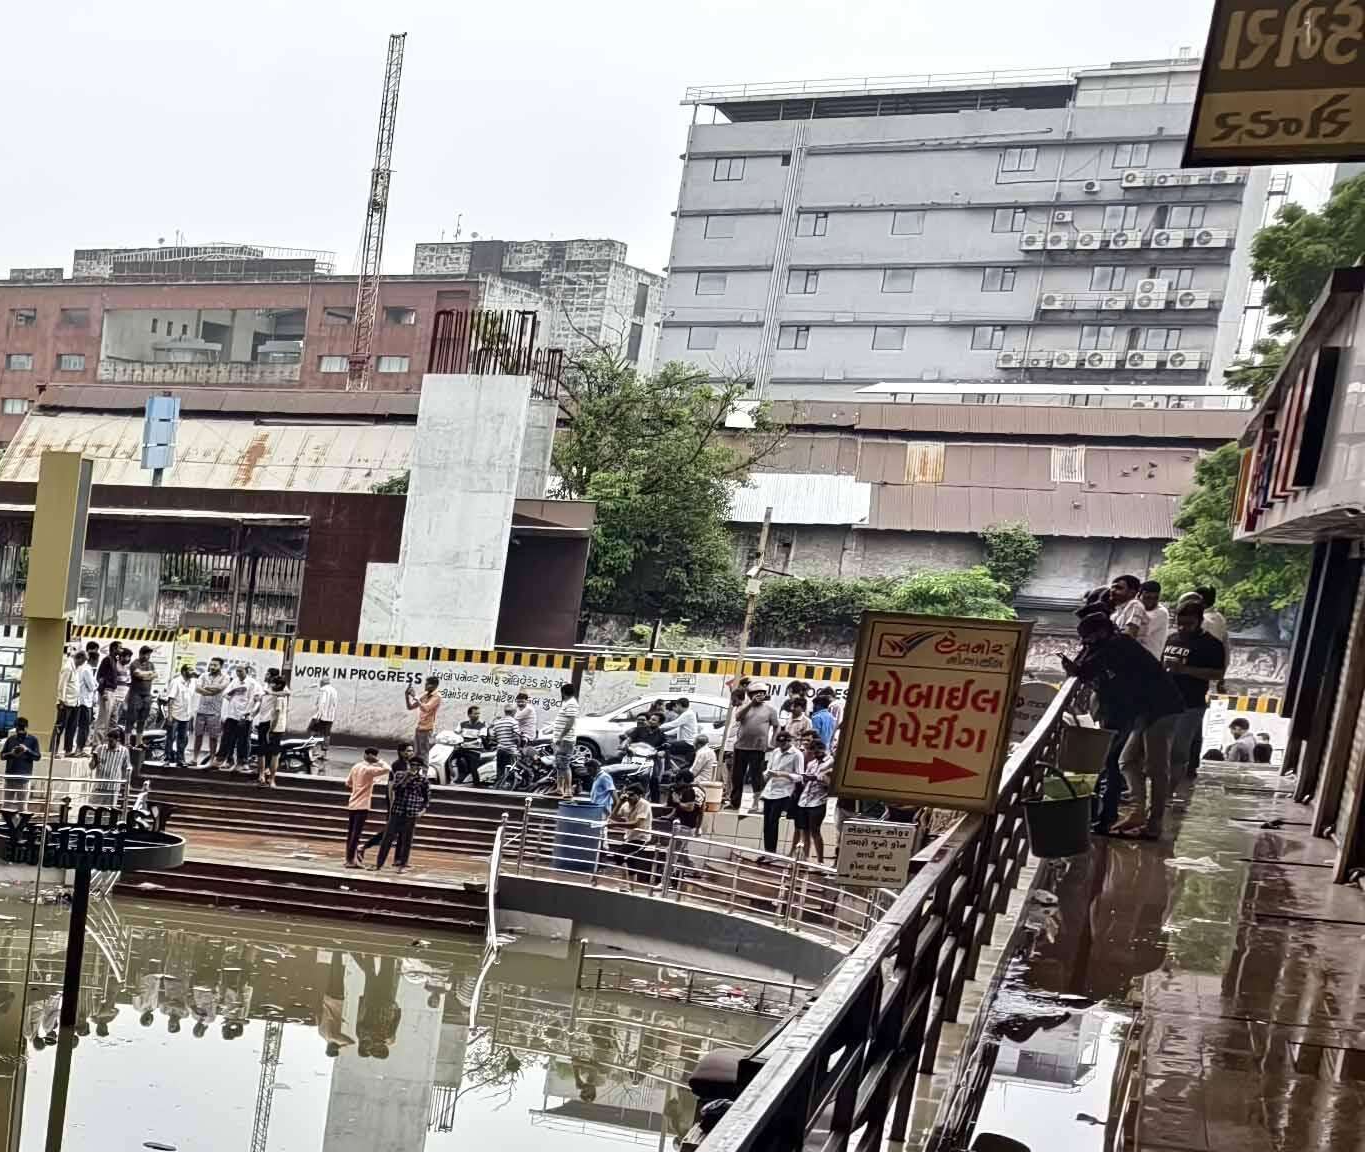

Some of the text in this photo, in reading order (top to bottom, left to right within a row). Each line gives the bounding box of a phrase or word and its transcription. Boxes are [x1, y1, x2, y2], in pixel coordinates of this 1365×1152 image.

[294, 665, 422, 685] WORK IN PROGRESS
[867, 671, 1002, 714] મોબાઈલ
